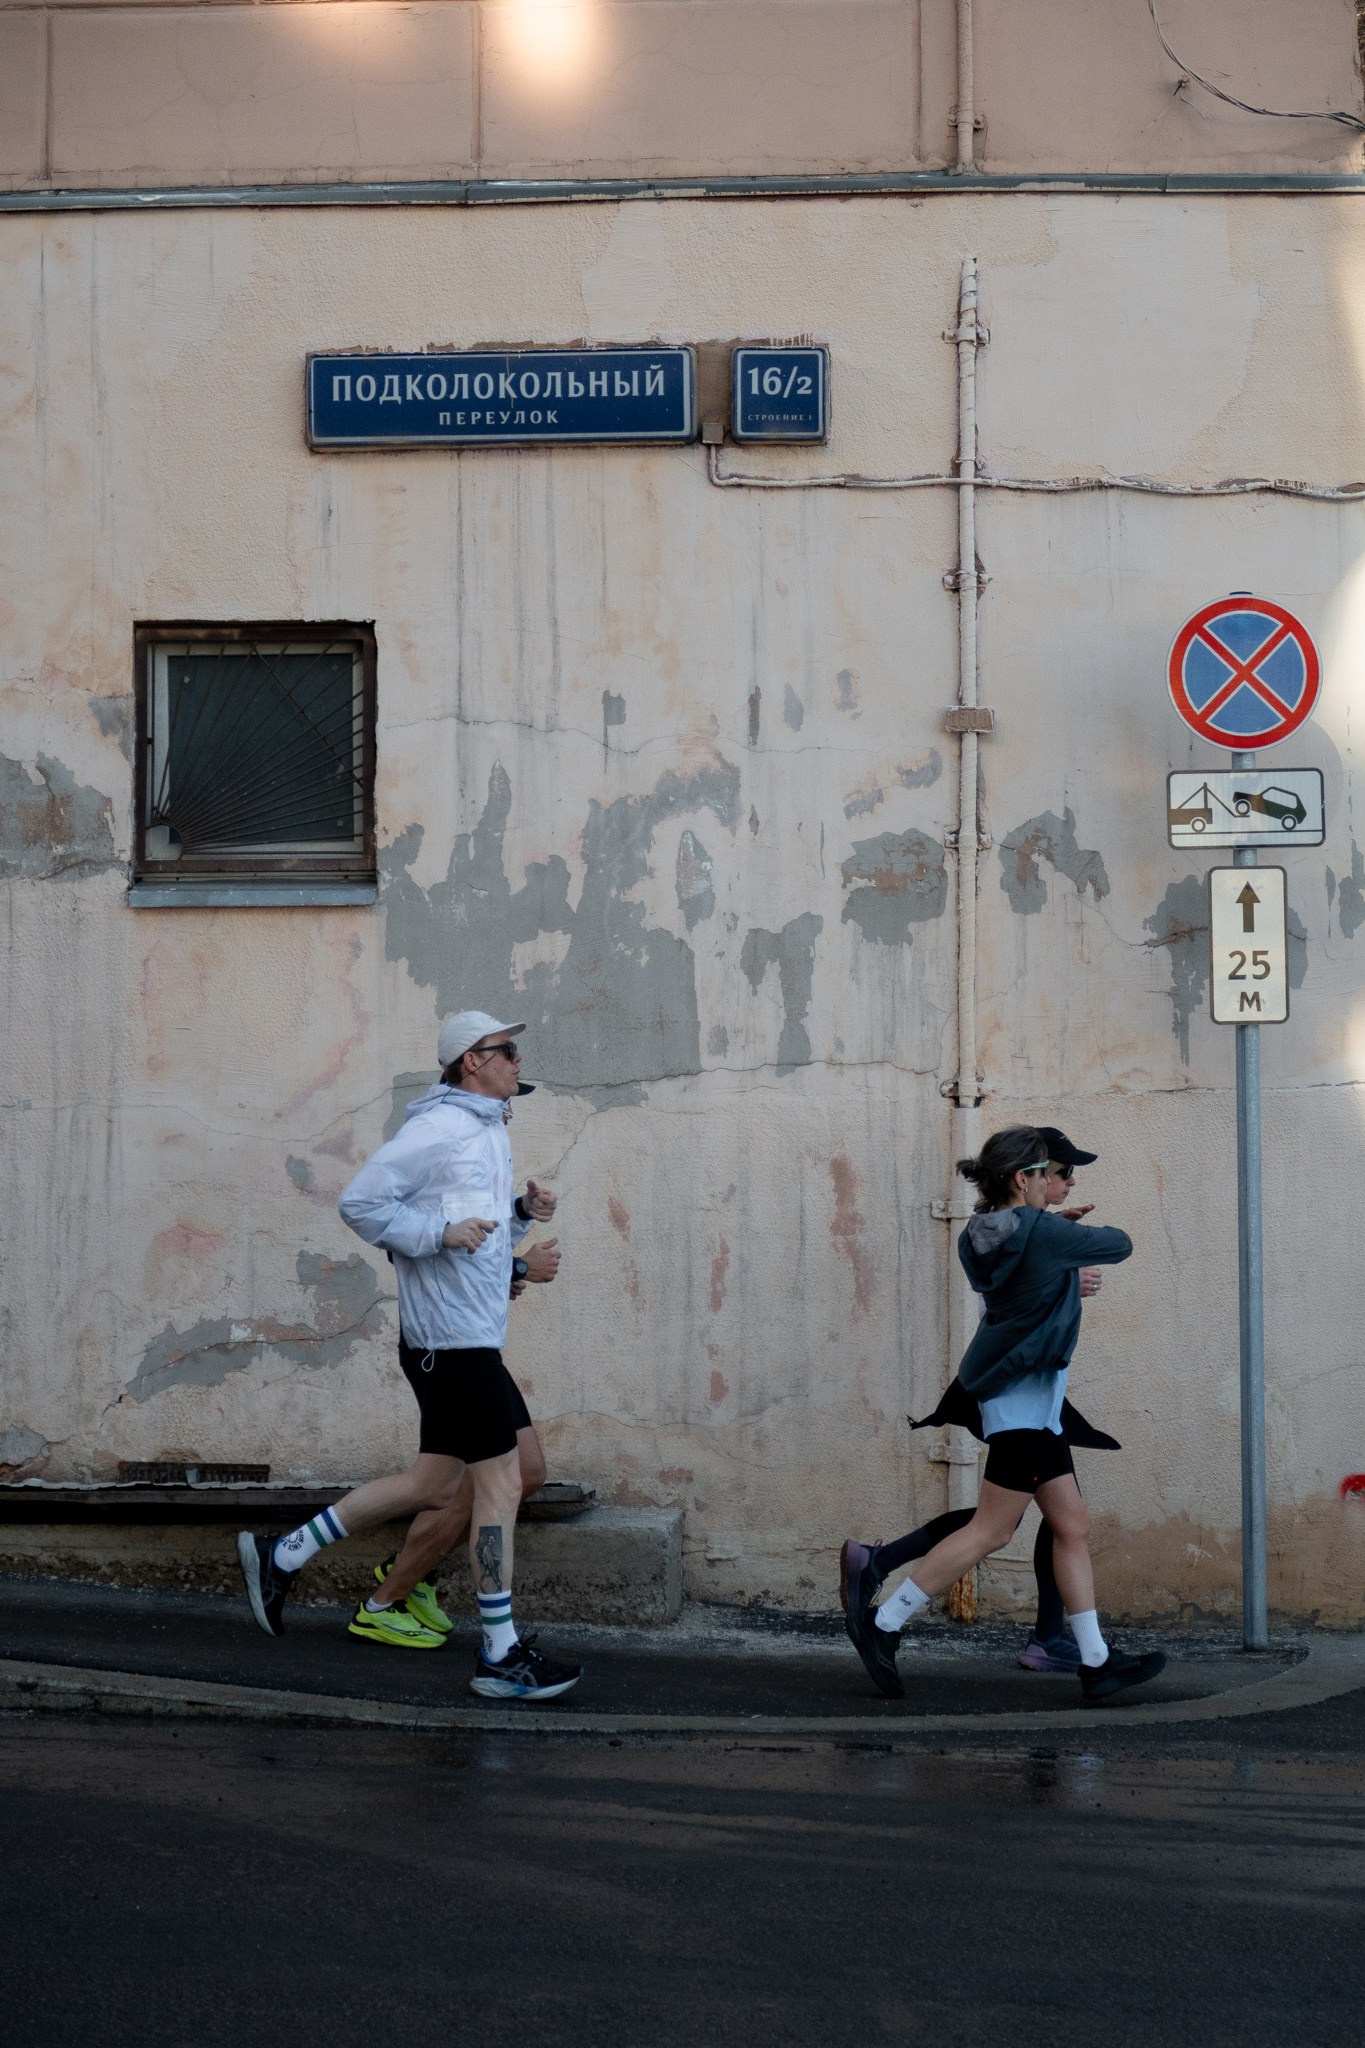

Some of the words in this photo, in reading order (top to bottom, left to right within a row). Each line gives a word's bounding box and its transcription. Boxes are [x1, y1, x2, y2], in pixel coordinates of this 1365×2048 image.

[332, 364, 665, 405] ПОДКОЛОКОЛЬНЫЙ
[747, 366, 812, 399] 16/2
[439, 410, 558, 426] ПЕРЕУЛОК
[1228, 950, 1271, 980] 25
